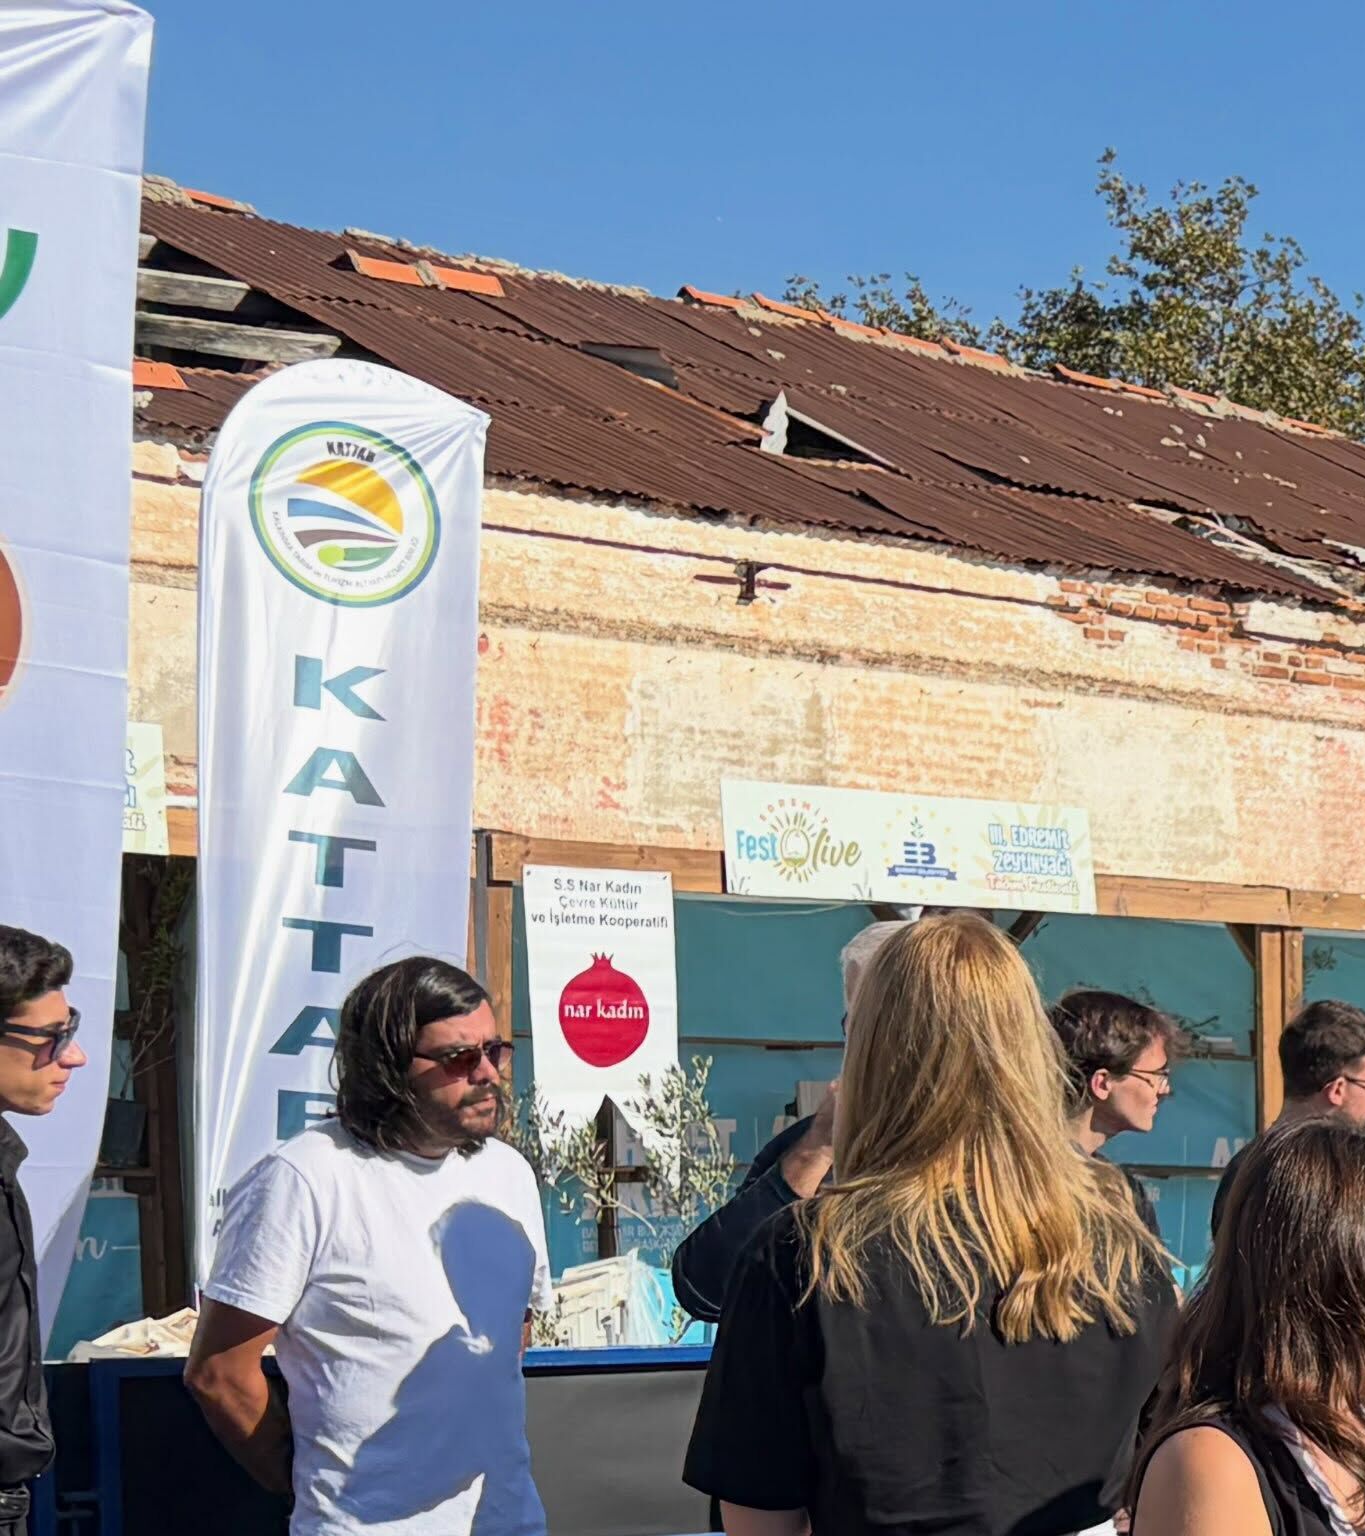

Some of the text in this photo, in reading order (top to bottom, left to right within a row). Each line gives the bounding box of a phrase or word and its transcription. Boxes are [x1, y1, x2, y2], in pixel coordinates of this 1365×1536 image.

[579, 880, 601, 892] Nar
[605, 881, 642, 894] Kadın
[559, 895, 639, 911] Çevre Kültür
[531, 912, 545, 924] ve
[600, 914, 668, 929] Kooperatifi
[564, 998, 644, 1019] nar kadın
